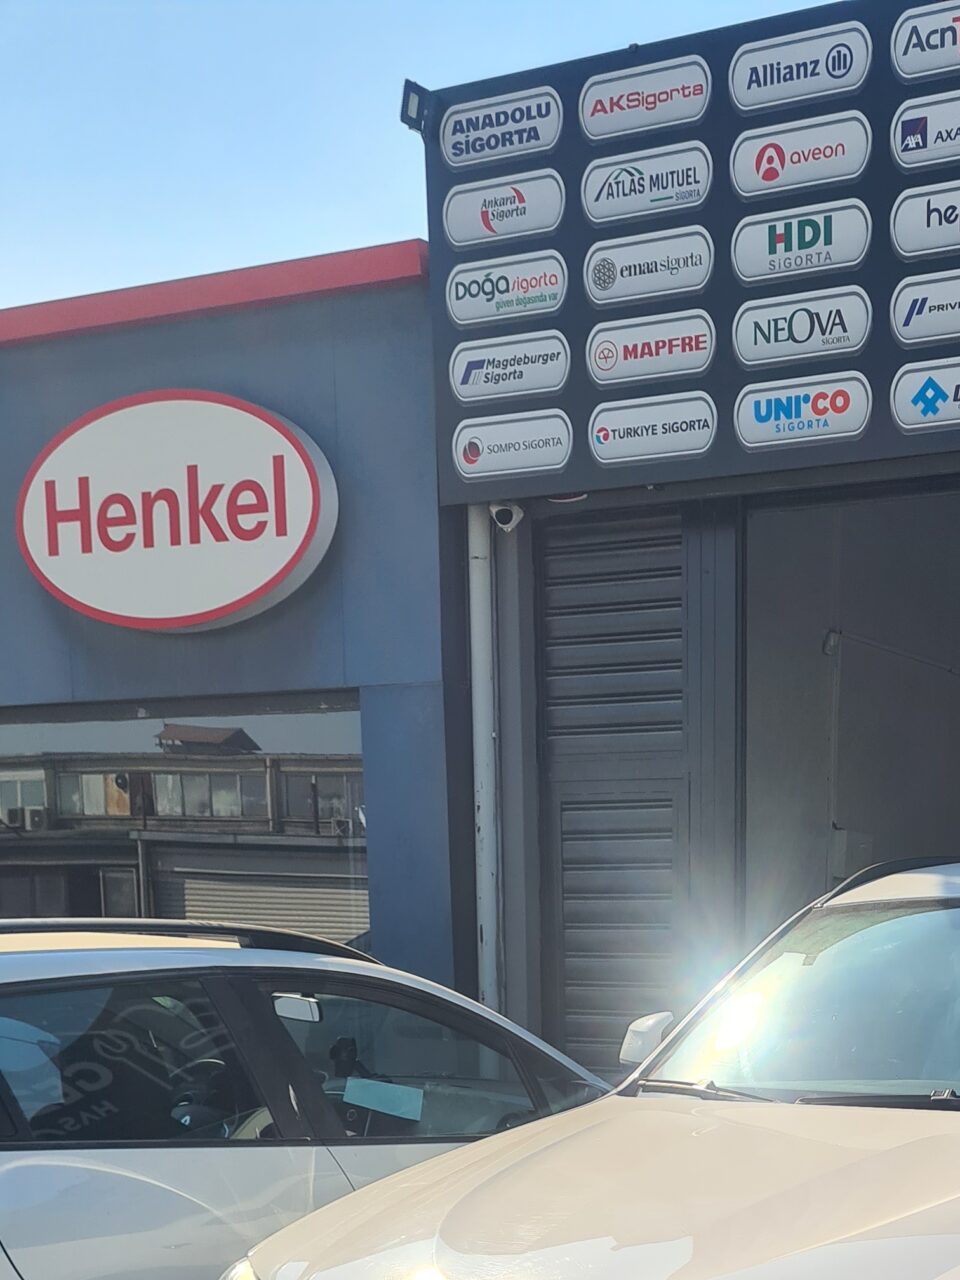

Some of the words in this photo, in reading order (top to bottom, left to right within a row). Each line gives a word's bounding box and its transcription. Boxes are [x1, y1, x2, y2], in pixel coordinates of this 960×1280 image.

[746, 59, 820, 91] Allianz
[590, 83, 704, 118] AKSigorta
[451, 101, 551, 136] ANADOLU
[789, 143, 846, 165] aveon
[606, 176, 645, 201] ATLAS
[649, 167, 700, 193] MUTUEL
[481, 194, 516, 210] Ankara
[490, 203, 527, 222] Sigorta
[768, 214, 833, 256] HDI
[619, 259, 659, 279] emaa
[659, 252, 703, 276] sigorta
[752, 307, 848, 346] NEOVA
[485, 351, 562, 370] Magdeburger
[622, 333, 708, 361] MAPFRE
[483, 369, 524, 385] Sigorta
[486, 441, 521, 455] SOMPO
[44, 454, 288, 557] Henkel
